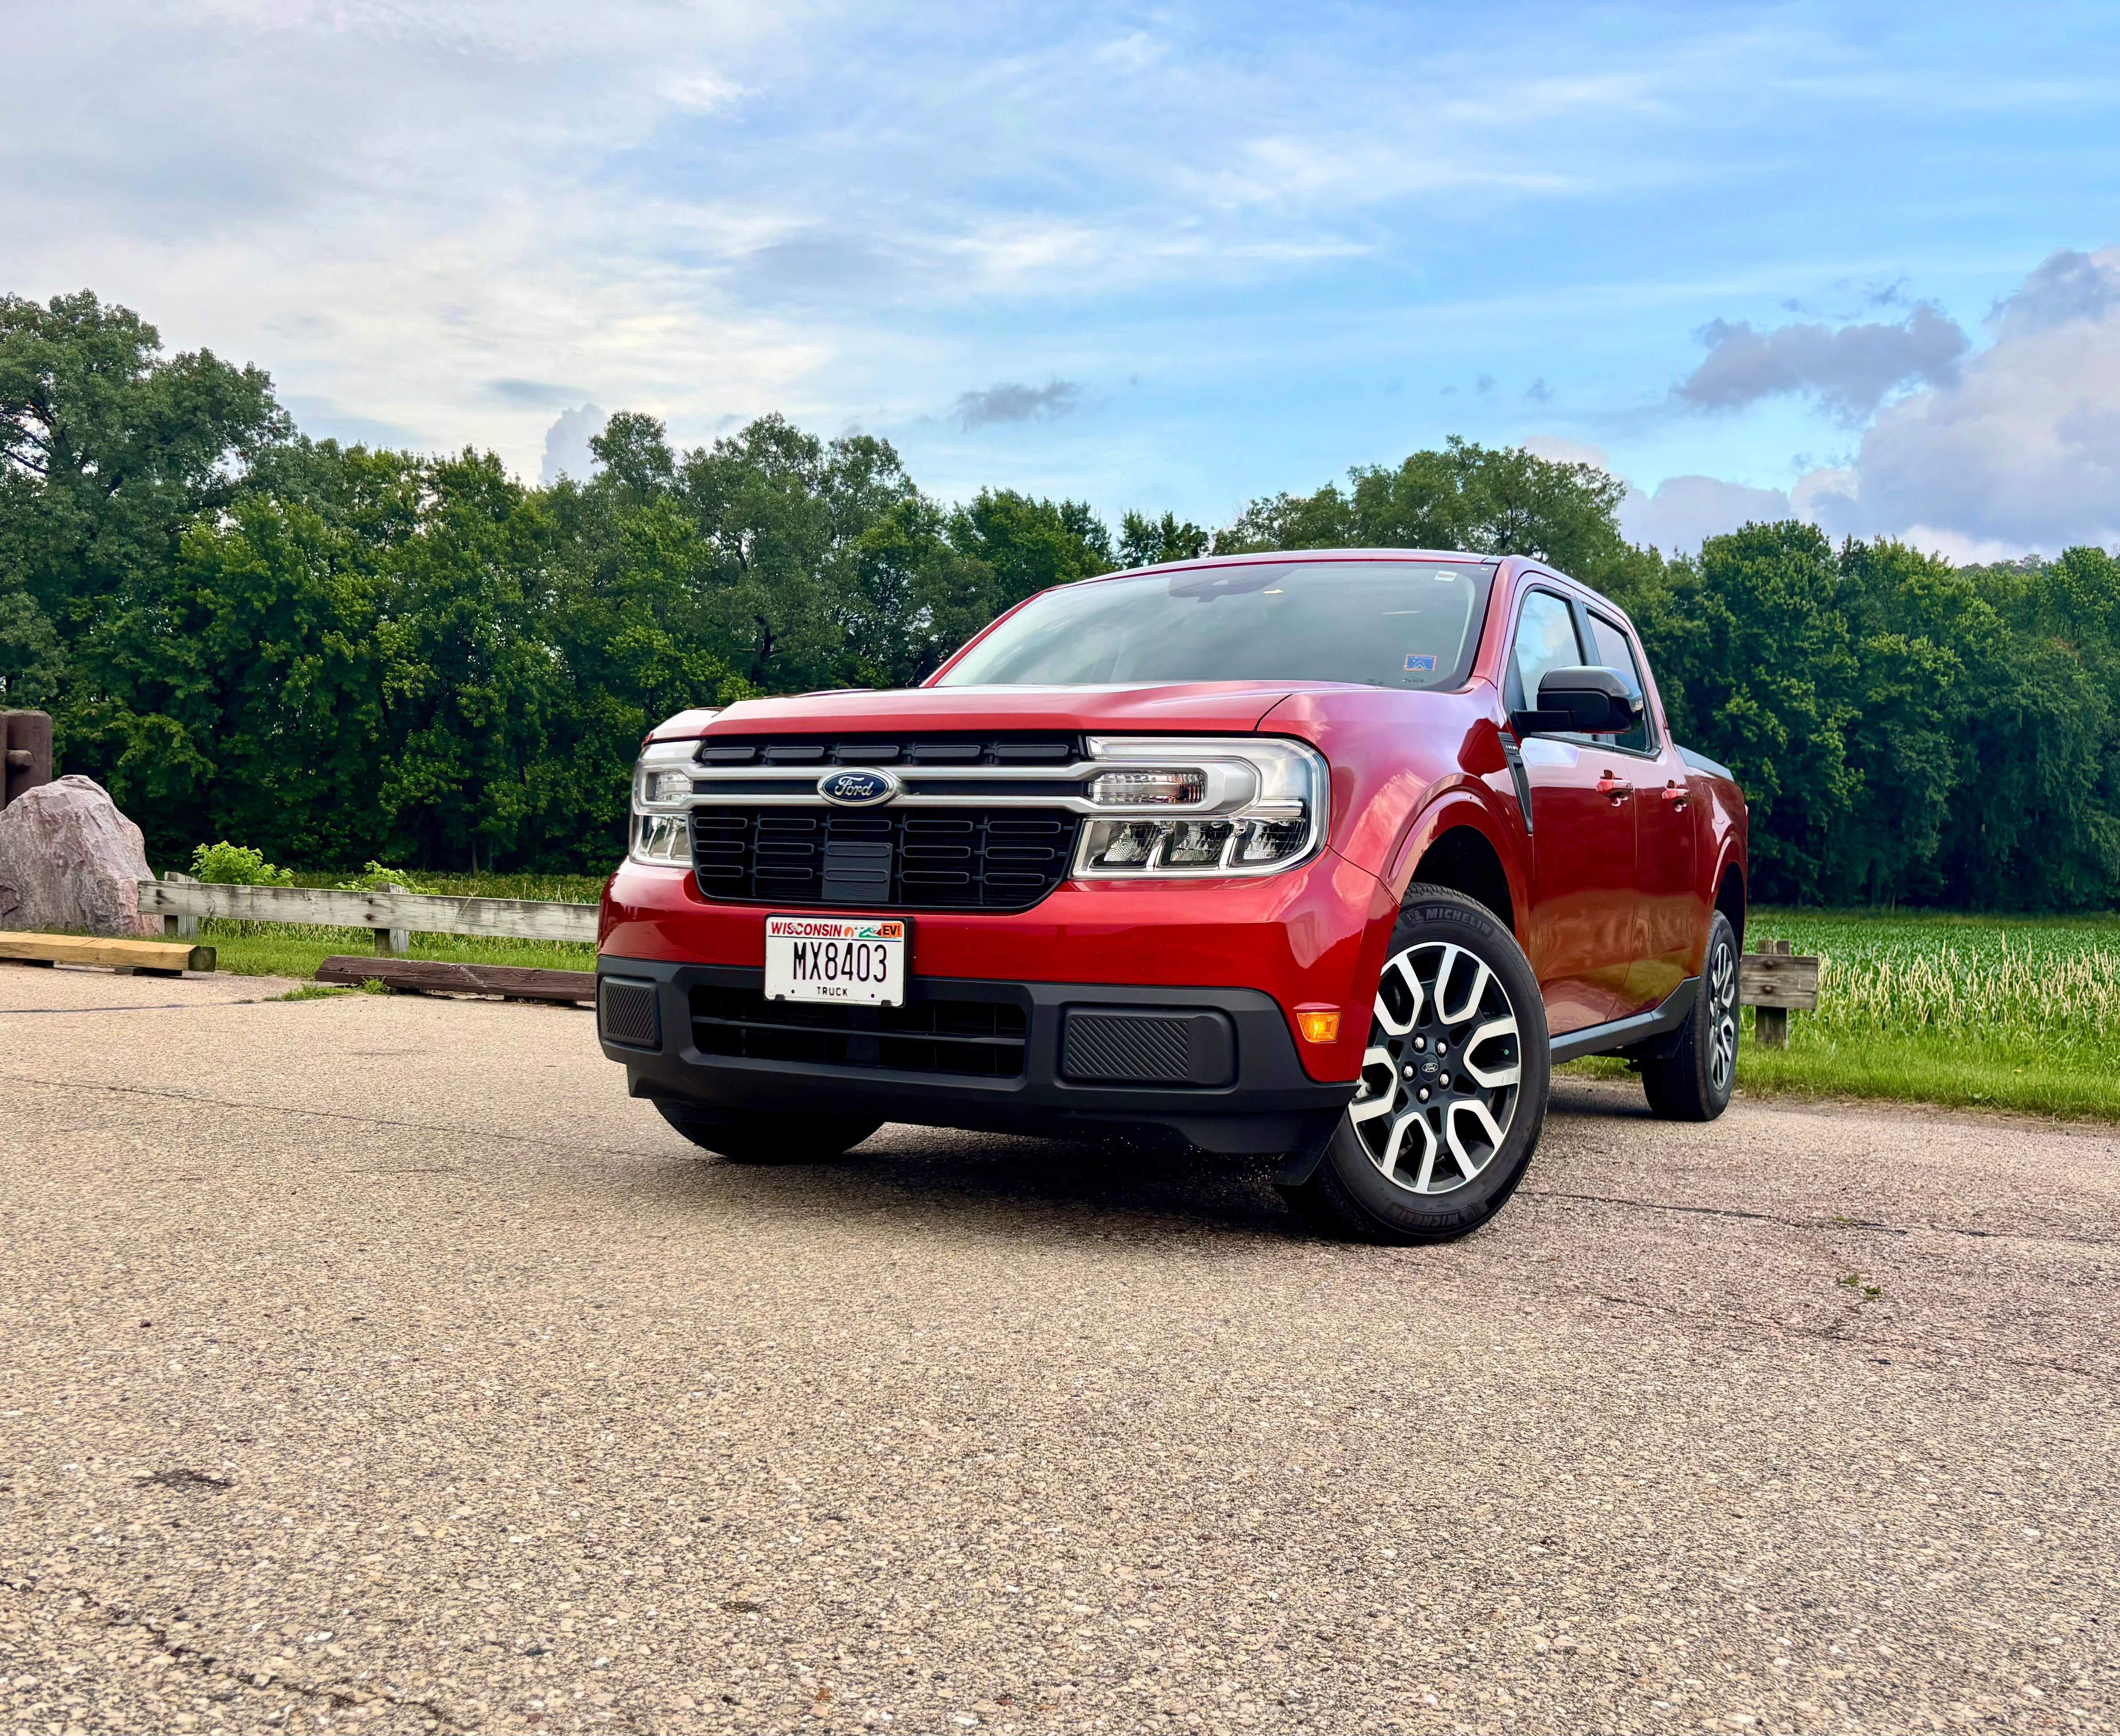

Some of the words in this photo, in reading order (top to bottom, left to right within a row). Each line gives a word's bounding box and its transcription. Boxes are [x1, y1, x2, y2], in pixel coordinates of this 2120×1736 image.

[835, 776, 874, 795] Ford
[771, 921, 842, 937] WISCONSIN
[1426, 909, 1491, 934] MICHELIN
[793, 941, 887, 982] MX8403
[817, 986, 848, 996] TRUCK
